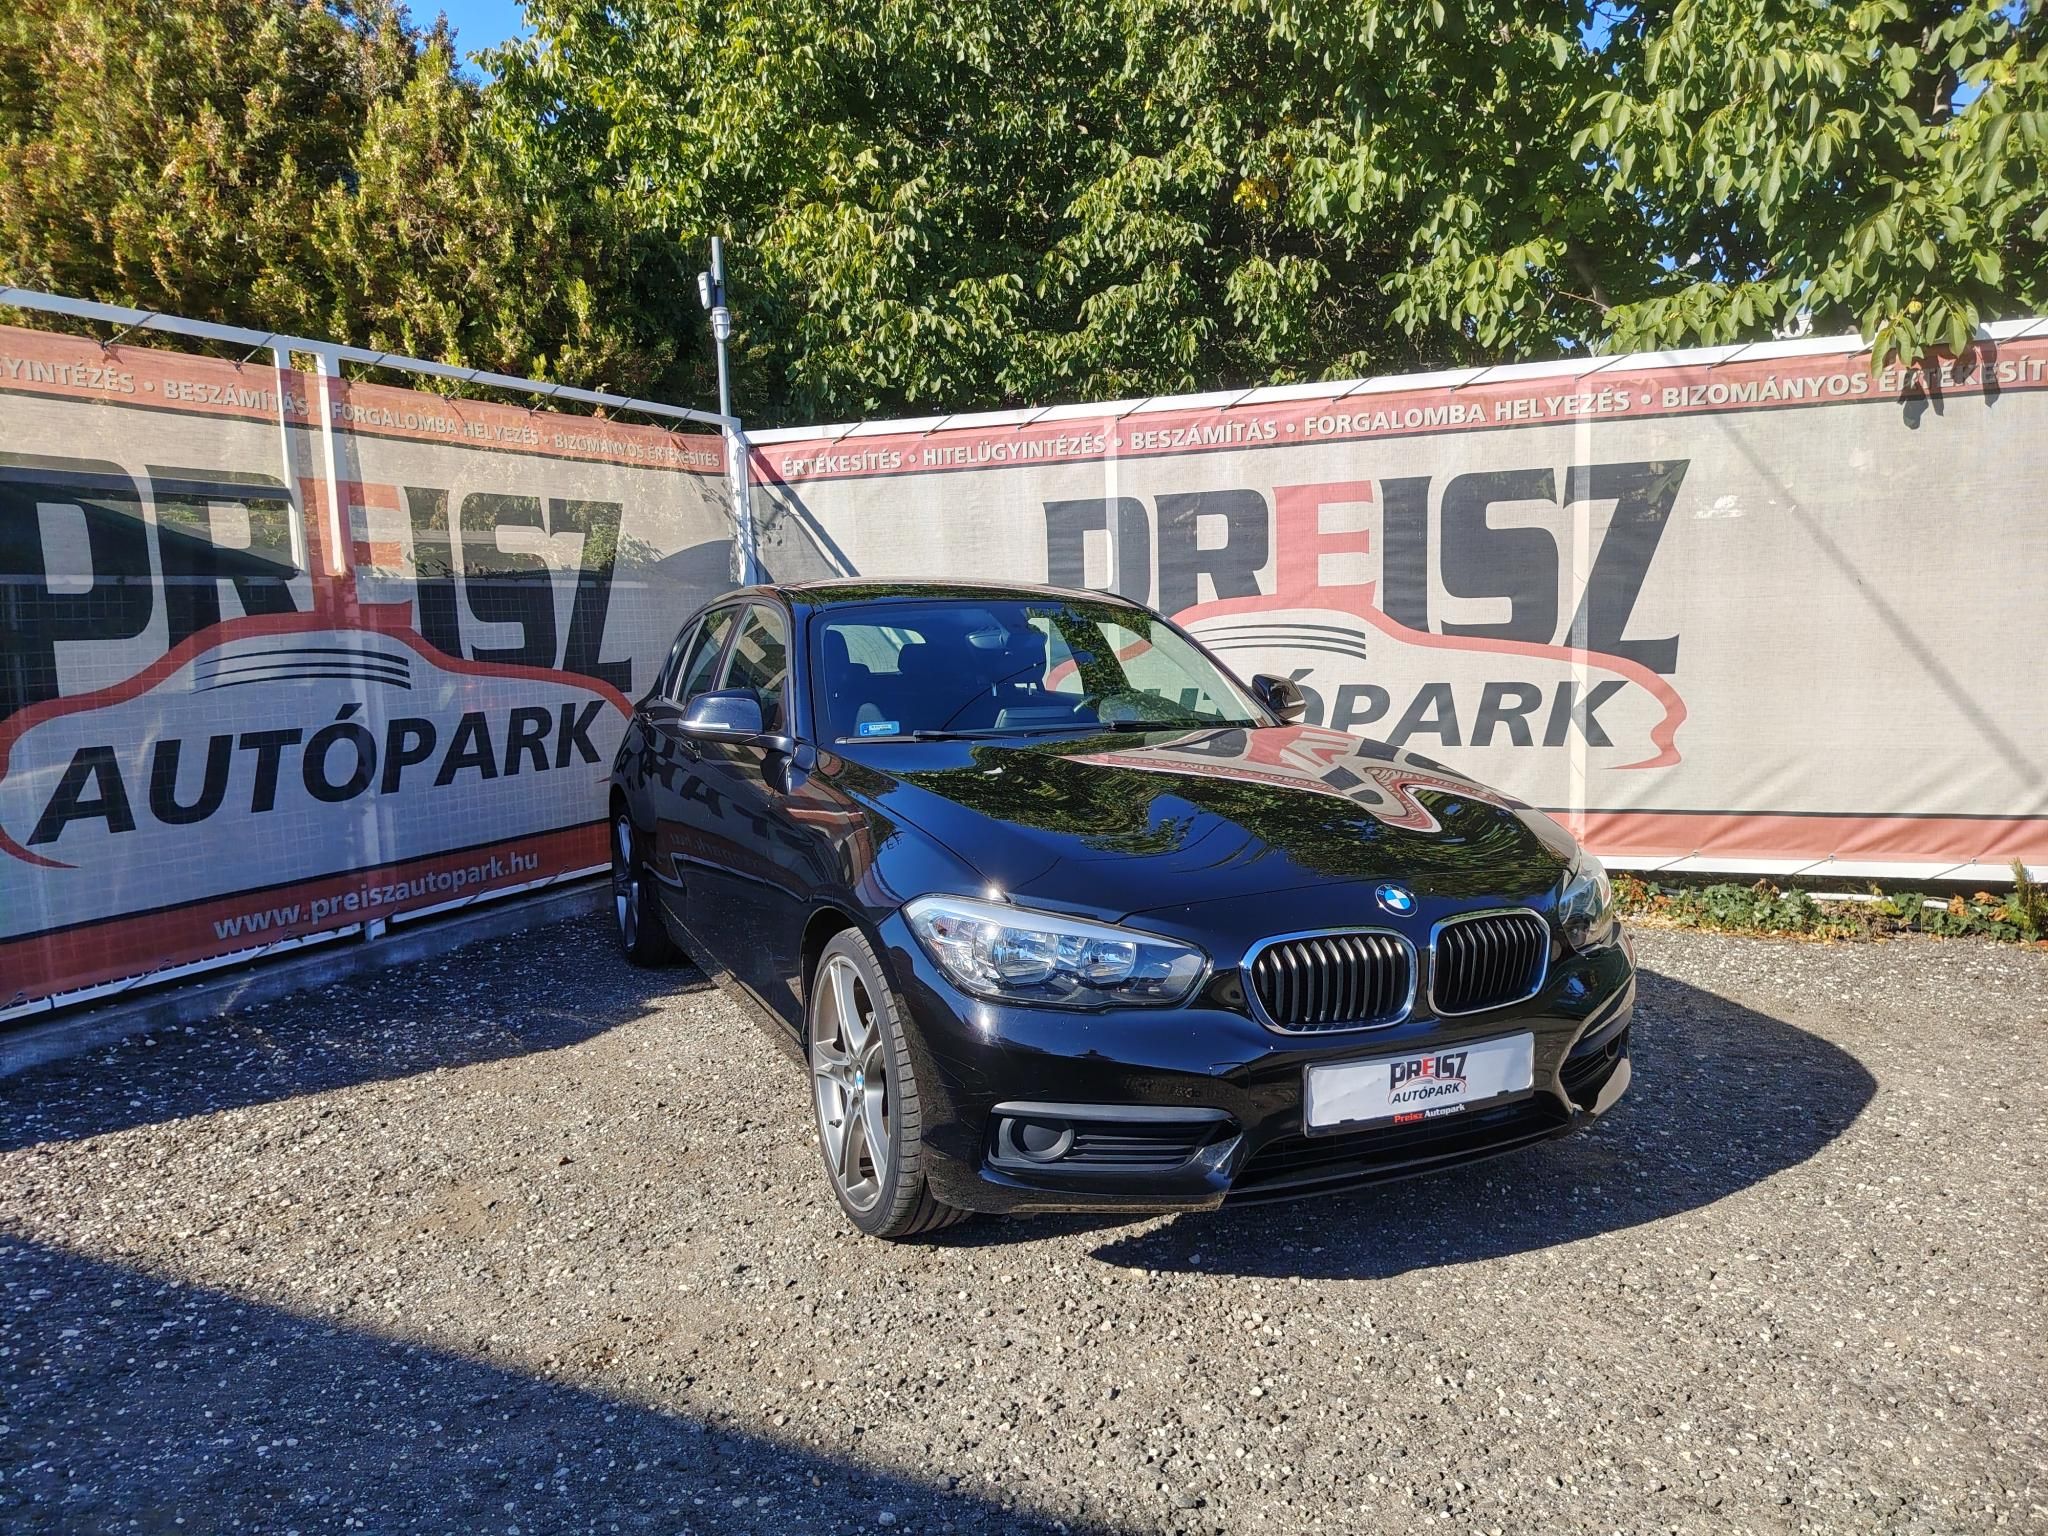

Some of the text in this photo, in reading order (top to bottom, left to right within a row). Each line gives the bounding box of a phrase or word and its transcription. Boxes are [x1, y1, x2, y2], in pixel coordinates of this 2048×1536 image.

[0, 357, 136, 394] YINTÉZÉS
[163, 379, 310, 417] BESZÁMÍTÁS
[332, 401, 459, 436] FORGALOMBA
[464, 422, 540, 446] HELYEZÉS
[781, 448, 902, 477] ÉRTÉKESÍTÉS
[923, 433, 1106, 467] HITELÜGYINTÉZÉS
[1130, 418, 1278, 450] BESZÁMÍTÁS
[1304, 403, 1487, 436] FORGALOMBA
[1495, 388, 1632, 422] HELYEZÉS
[1662, 373, 1869, 408] BIZOMÁNYOS
[0, 451, 633, 718] PREISZ
[26, 700, 606, 846] AUTÓPARK
[213, 851, 539, 940] www.preiszautopark.hu
[1390, 1052, 1468, 1090] PREISZ
[1391, 1082, 1461, 1104] AUTÓPARK
[1394, 1104, 1466, 1123] Preisz Autopark
